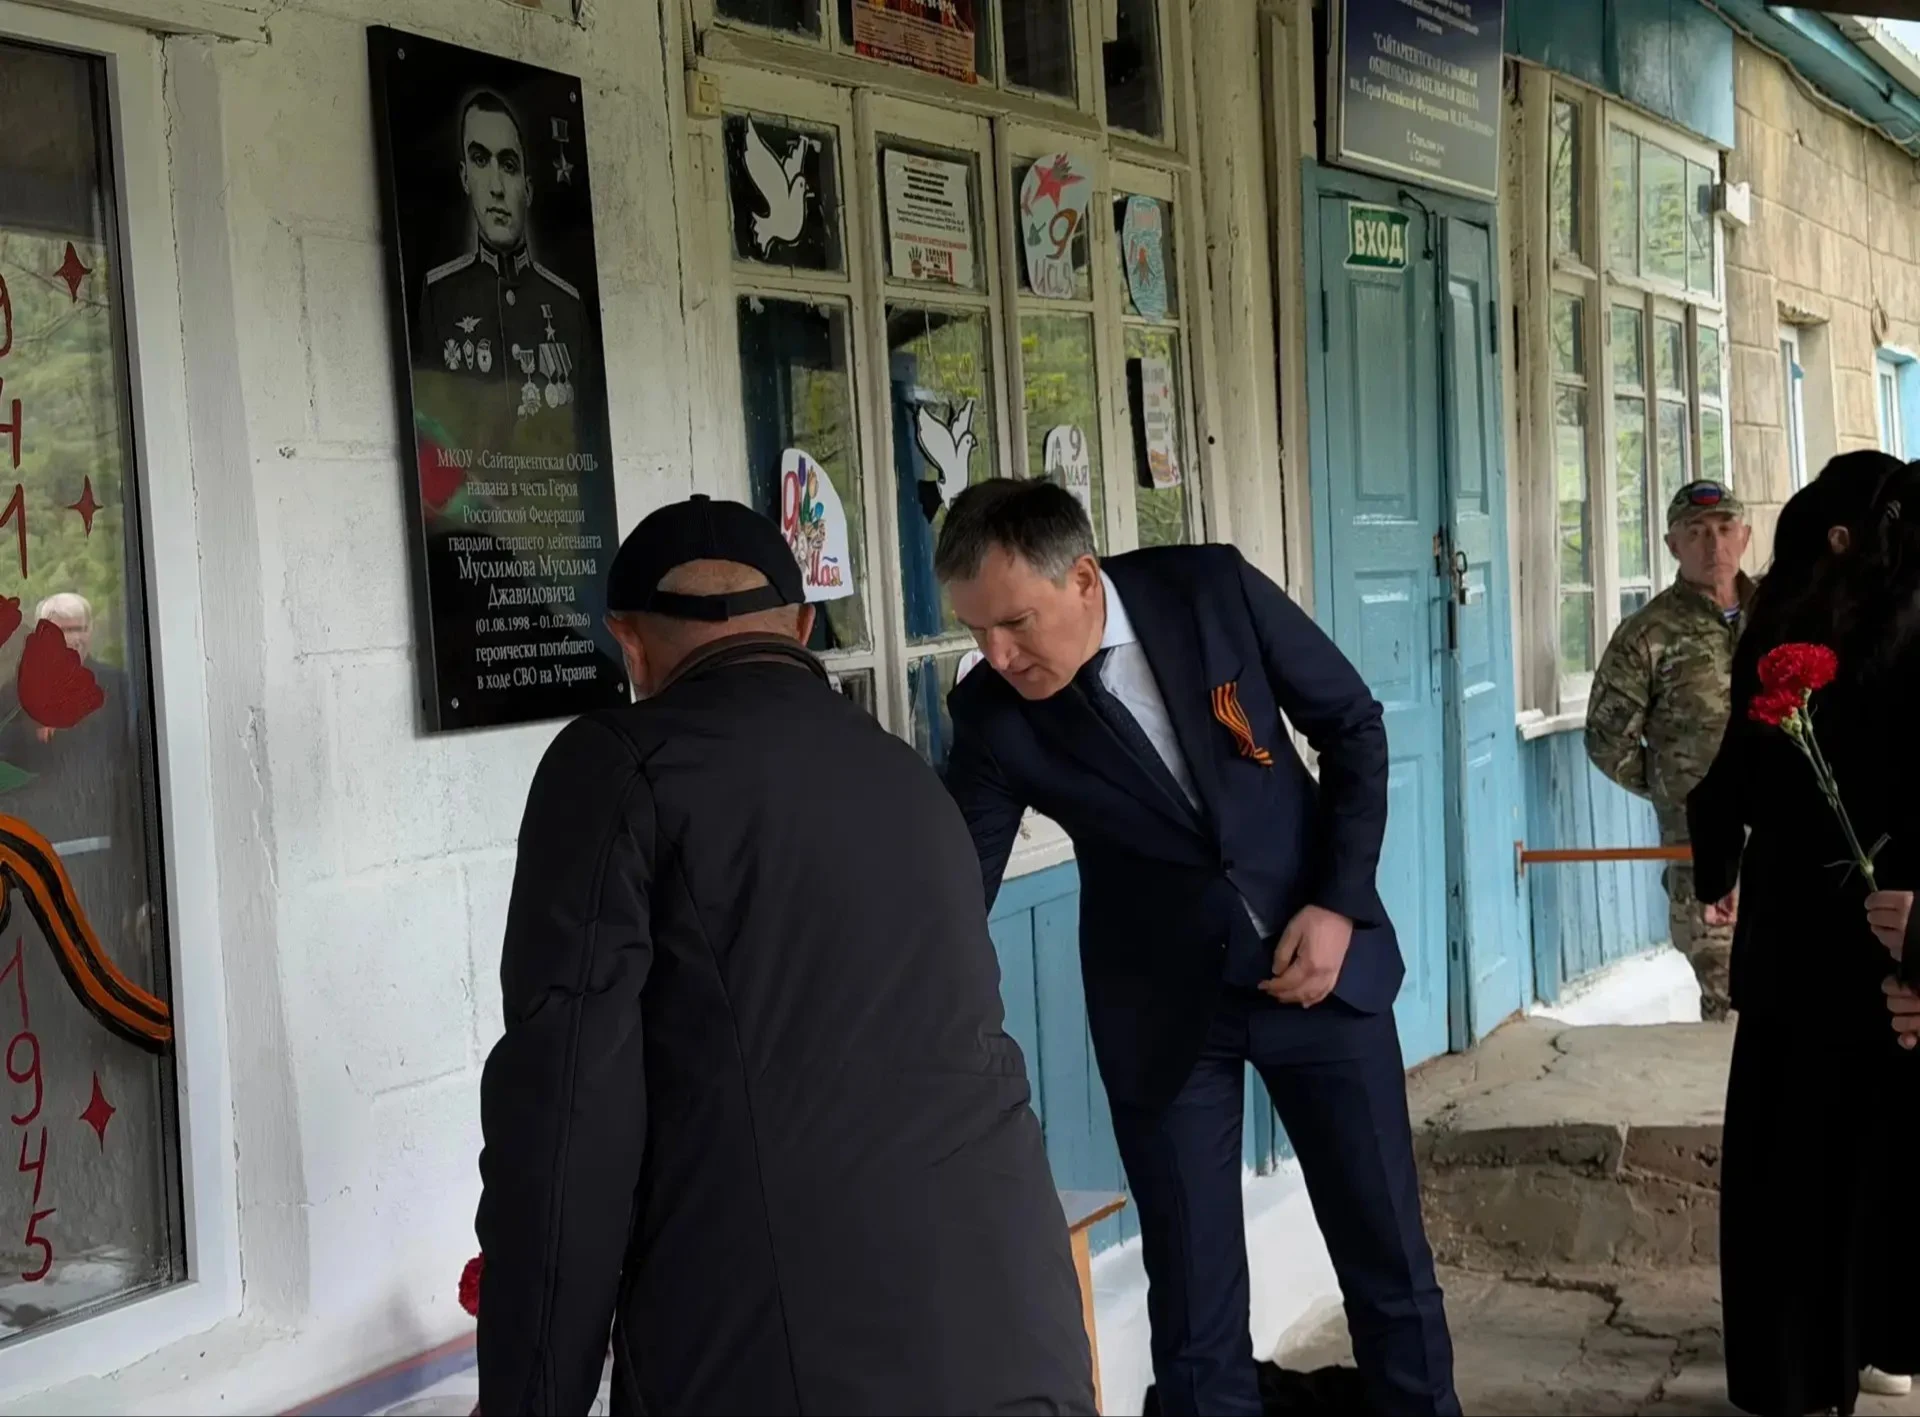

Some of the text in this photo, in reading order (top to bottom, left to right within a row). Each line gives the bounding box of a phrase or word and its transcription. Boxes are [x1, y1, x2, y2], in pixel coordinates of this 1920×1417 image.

[1046, 208, 1078, 260] 9
[1355, 219, 1404, 265] ВХОД
[1069, 425, 1081, 461] 9
[436, 448, 599, 475] МКОУ «Сайтаркентская ООШ»
[467, 479, 578, 502] названа в честь Героя
[463, 505, 585, 528] Российской Федерации
[784, 471, 800, 548] 9
[448, 533, 602, 556] гвардии старшего лейтенанта
[458, 554, 597, 586] Муслимова Муслима
[488, 583, 576, 610] Джавидовича
[475, 617, 530, 636] (01.08.1998
[476, 635, 595, 667] героически погибшего
[477, 664, 597, 690] в ходе СВО на Украине
[0, 936, 56, 1281] 1945
